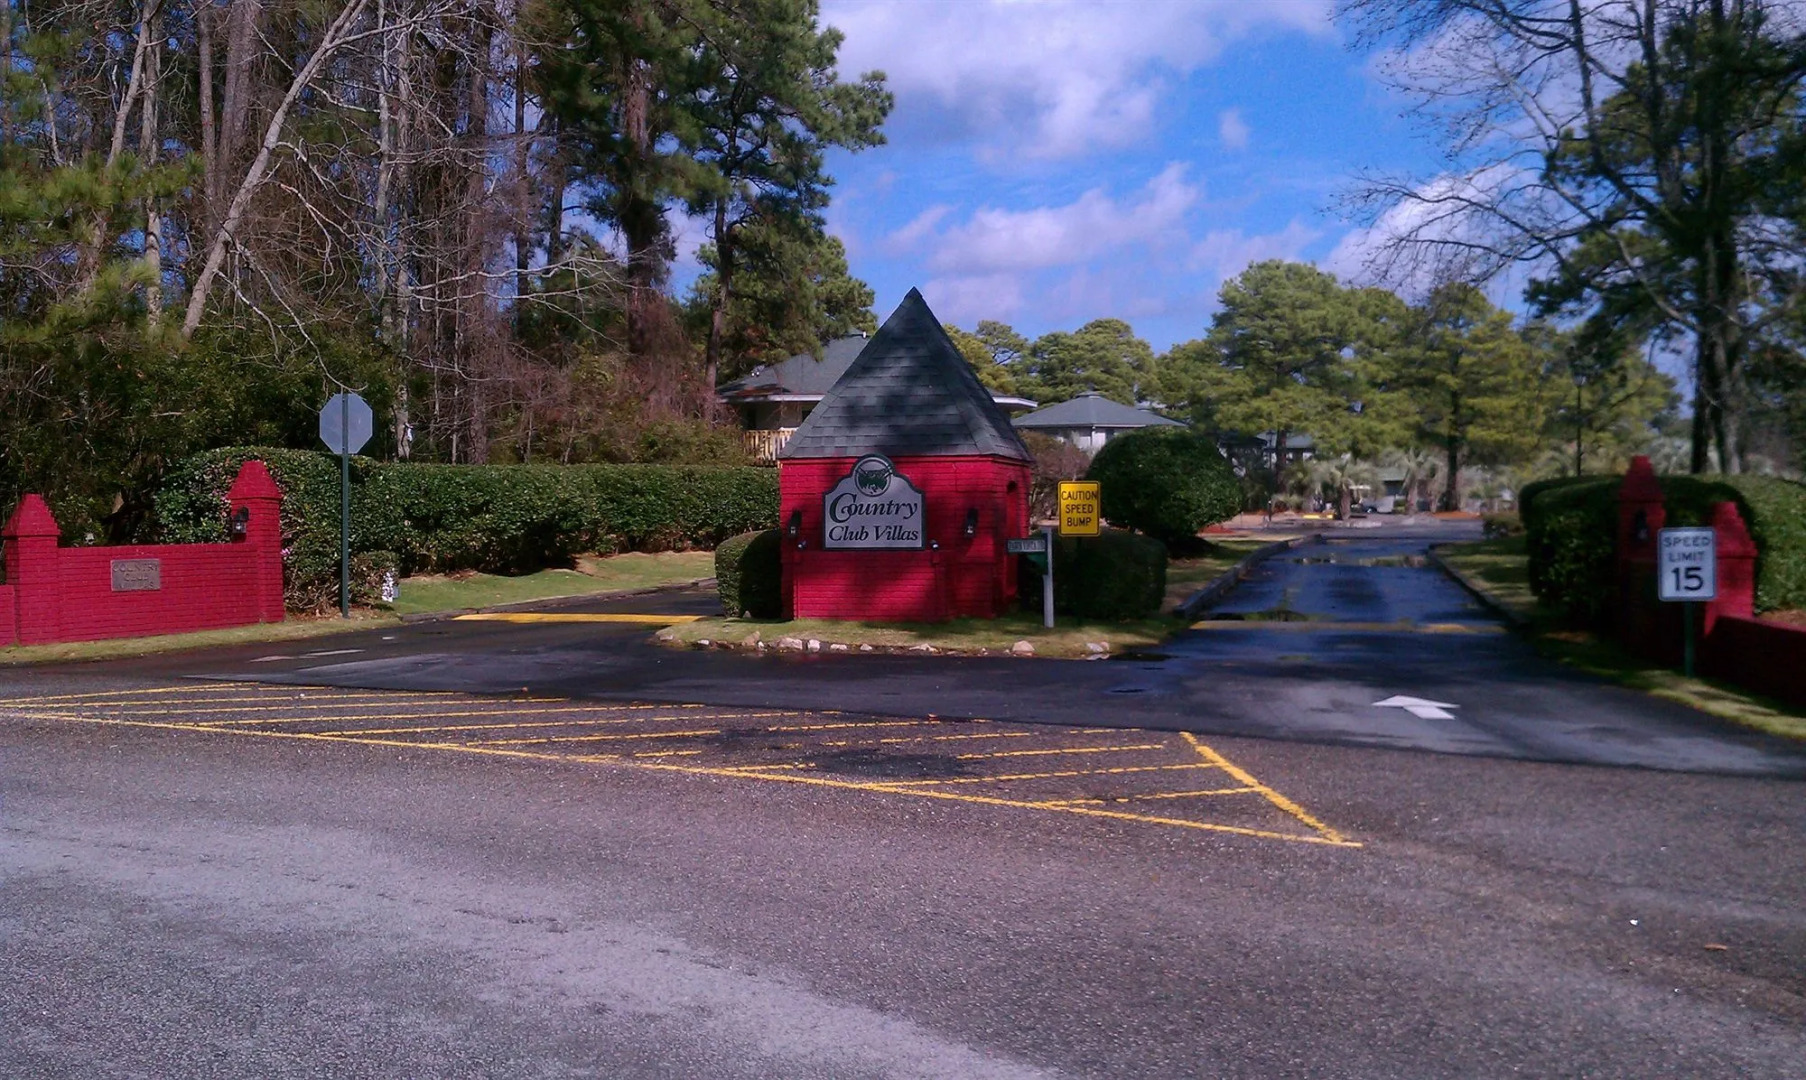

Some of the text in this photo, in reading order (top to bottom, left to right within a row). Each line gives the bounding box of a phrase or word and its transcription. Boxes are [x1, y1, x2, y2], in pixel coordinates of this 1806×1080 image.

[1061, 490, 1098, 501] CAUTION
[829, 492, 918, 523] Country
[1065, 503, 1094, 514] SPEED
[1066, 517, 1092, 527] BUMP
[828, 525, 919, 542] Club Villas
[1663, 536, 1711, 547] SPEED
[1668, 550, 1705, 562] LIMIT
[1671, 566, 1704, 592] 15
